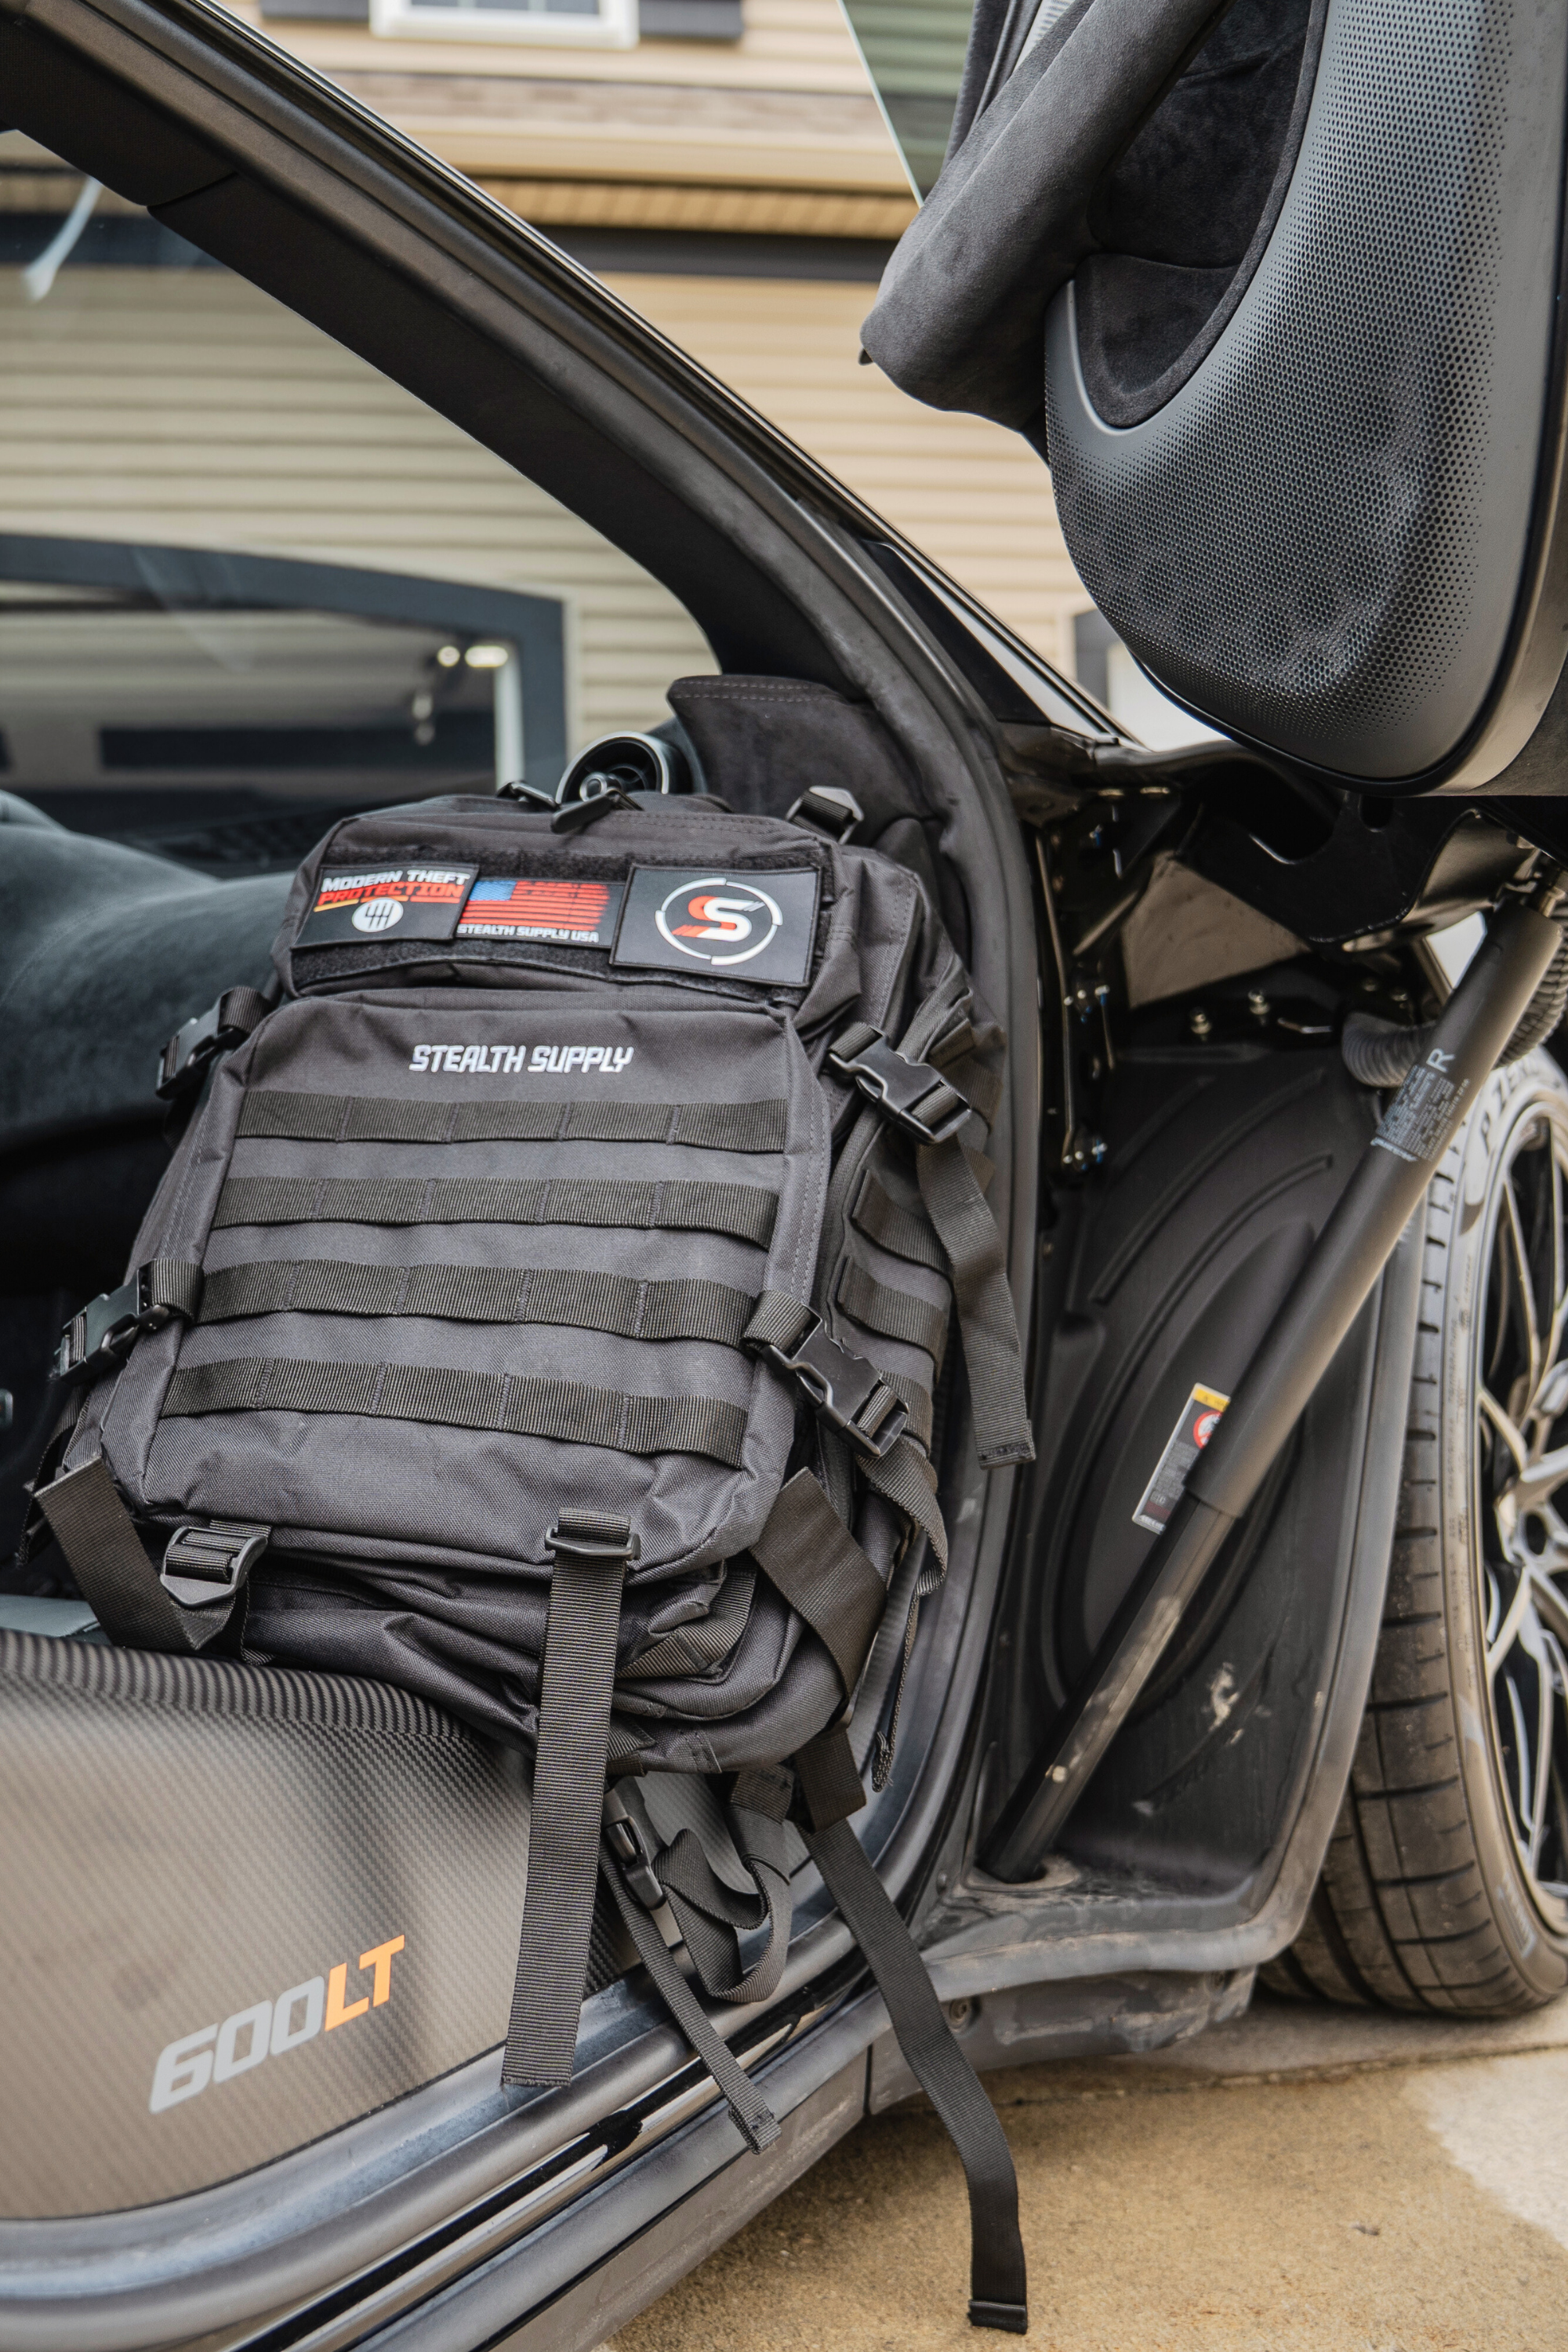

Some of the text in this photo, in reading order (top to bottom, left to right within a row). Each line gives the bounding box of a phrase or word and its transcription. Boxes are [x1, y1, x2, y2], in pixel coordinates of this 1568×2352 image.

[321, 869, 470, 892] MODERN THEFT
[318, 881, 465, 906] PROTECTION
[456, 924, 599, 942] STEALTH SUPPLY USA
[408, 1044, 634, 1073] STEALTH SUPPLY
[1426, 1048, 1456, 1073] R
[149, 1934, 405, 2114] 600LT
